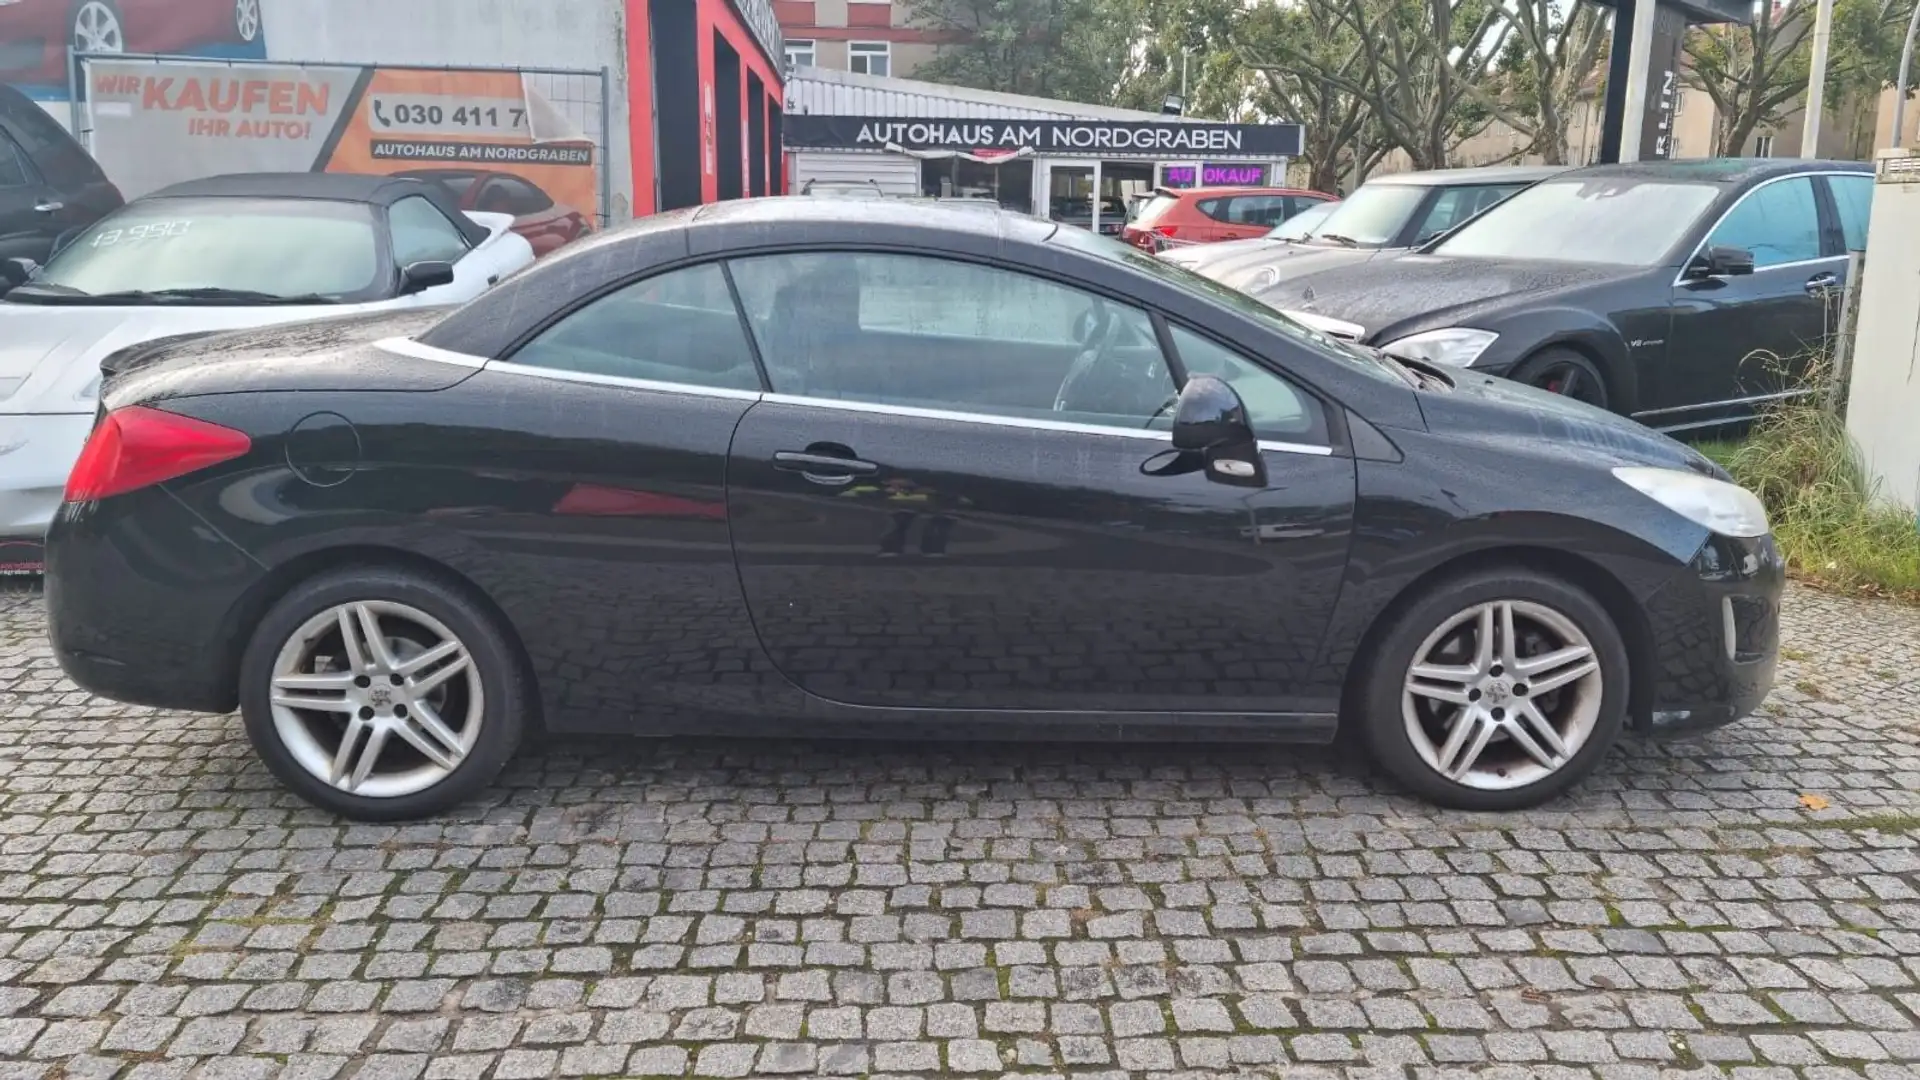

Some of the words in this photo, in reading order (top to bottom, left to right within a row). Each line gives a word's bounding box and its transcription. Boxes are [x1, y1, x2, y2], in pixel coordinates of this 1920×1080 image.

[95, 75, 141, 95] WIR
[142, 76, 330, 117] KAUFEN
[394, 104, 443, 125] 030
[452, 106, 498, 126] 411
[509, 108, 531, 128] 7
[188, 118, 230, 136] IHR
[235, 121, 311, 140] AUTO!
[856, 123, 994, 144] AUTOHAUS
[998, 125, 1041, 146] AM
[1052, 126, 1242, 149] NORDGRABEN
[374, 144, 456, 157] AUTOHAUS
[459, 145, 482, 158] AM
[485, 146, 589, 161] NORDGRABEN
[1168, 167, 1263, 183] AUOKAUF
